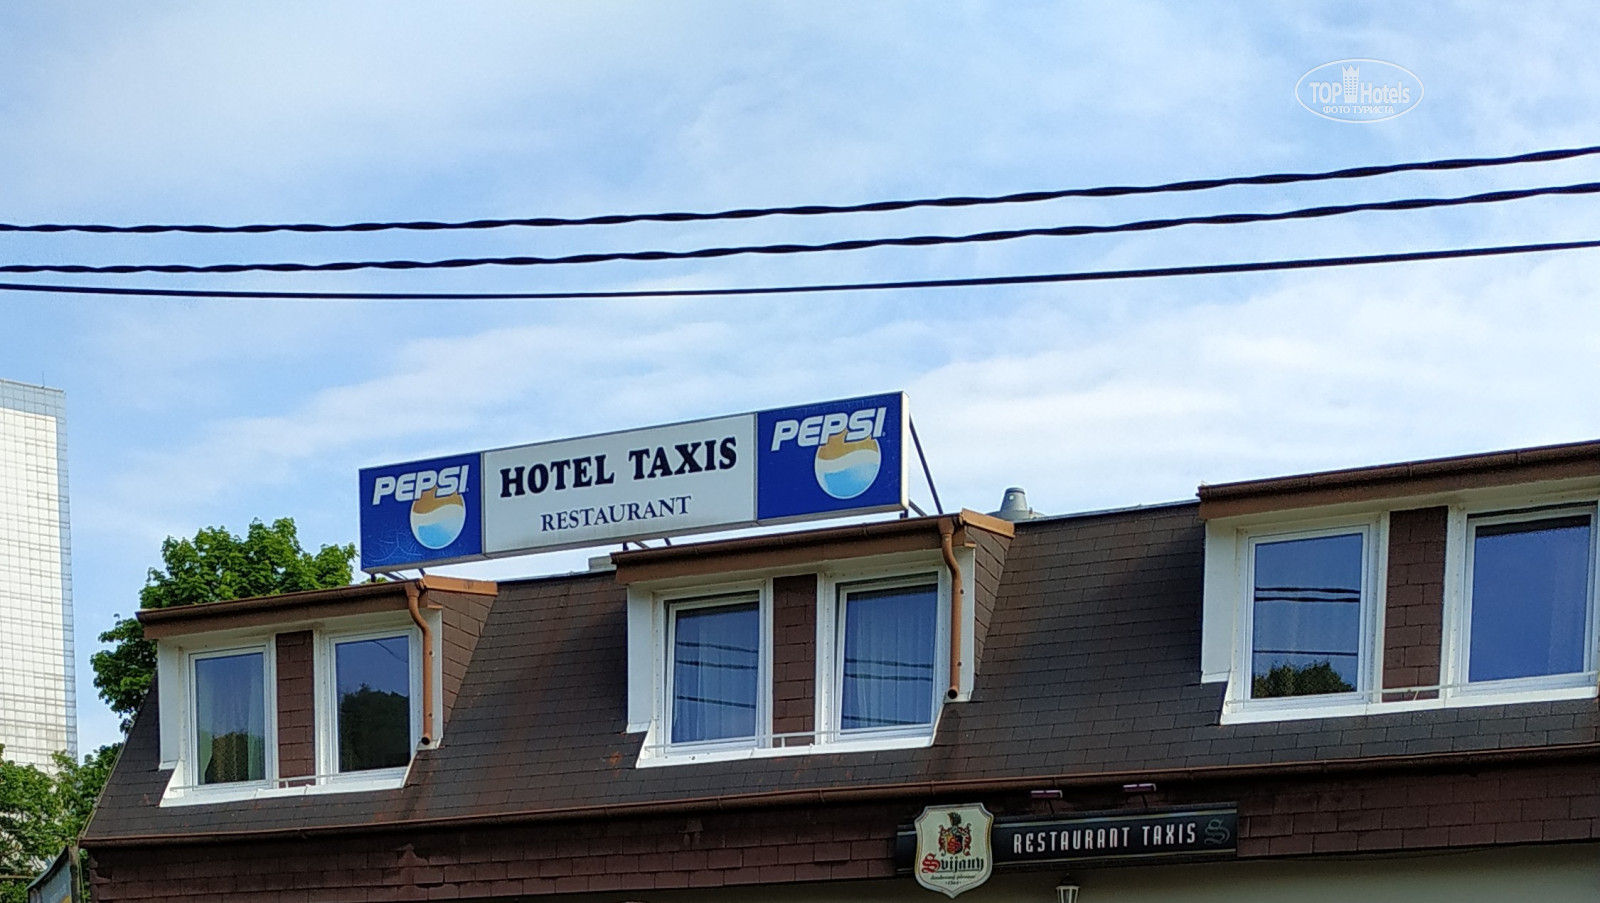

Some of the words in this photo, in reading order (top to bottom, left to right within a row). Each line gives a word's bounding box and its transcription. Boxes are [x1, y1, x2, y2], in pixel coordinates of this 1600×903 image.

[770, 407, 887, 451] PEPSI
[372, 464, 469, 505] PEPSI
[500, 454, 615, 498] HOTEL
[628, 436, 737, 480] TAXIS
[541, 495, 692, 532] RESTAURANT
[1013, 827, 1131, 854] RESTAURANT
[1142, 822, 1196, 846] TAXIS
[921, 852, 984, 873] Svijany
